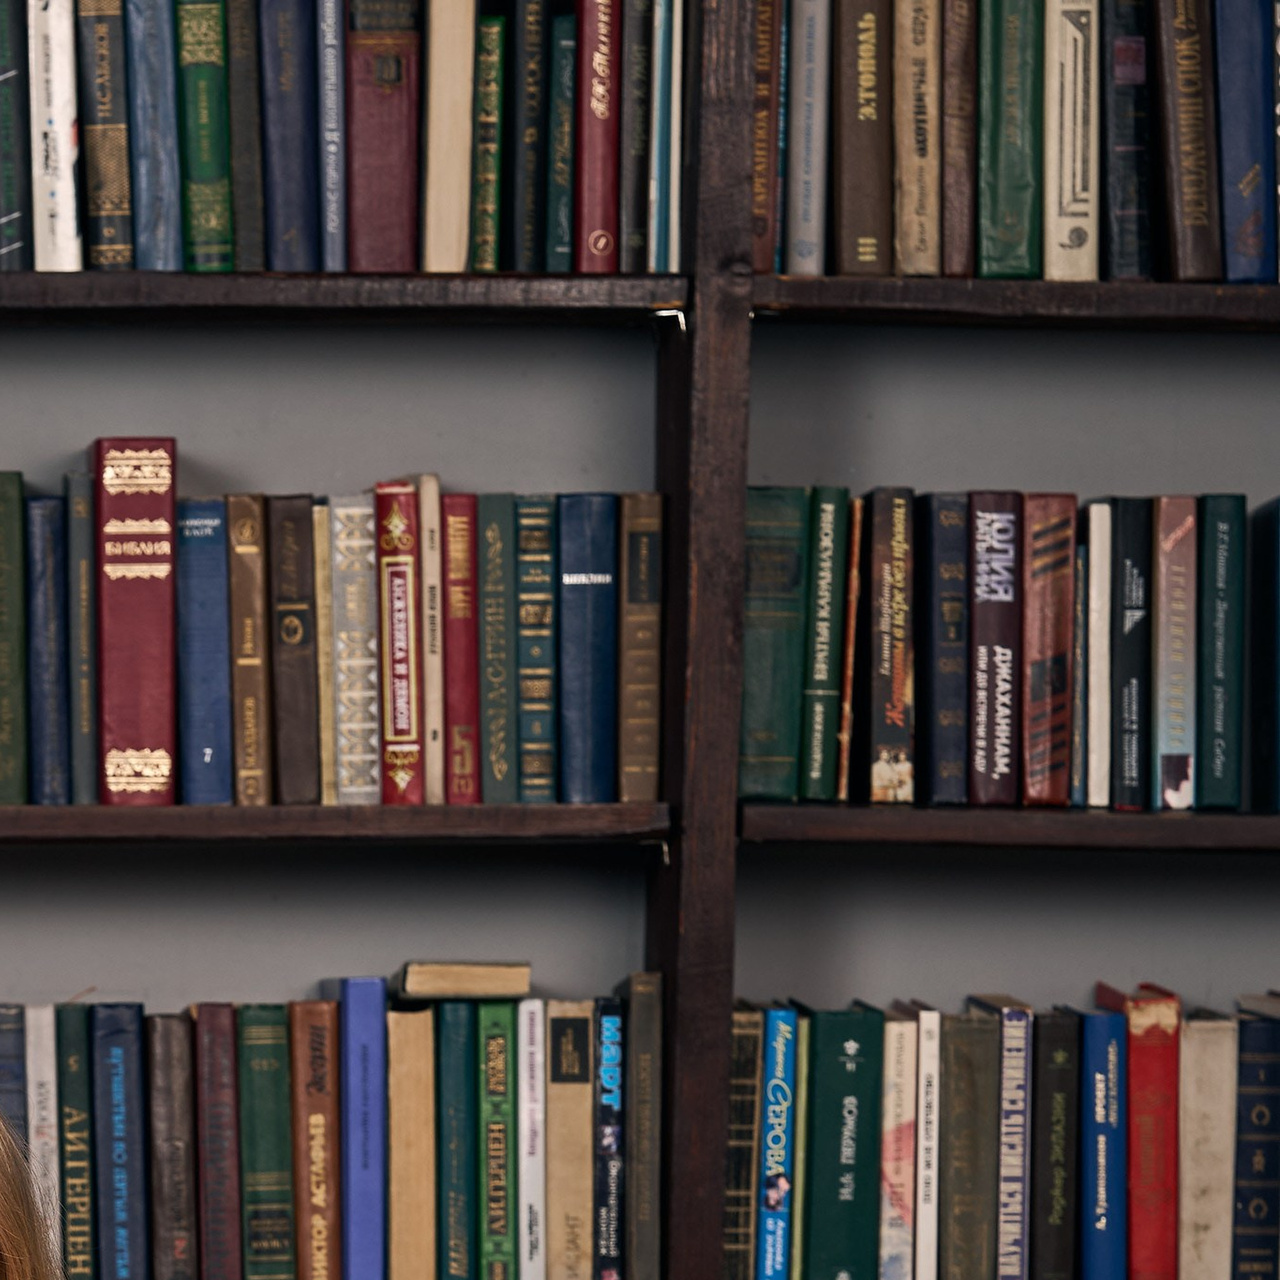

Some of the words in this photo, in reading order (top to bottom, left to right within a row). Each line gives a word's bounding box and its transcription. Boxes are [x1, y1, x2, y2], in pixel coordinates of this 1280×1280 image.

[856, 11, 878, 121] Э.ТОПОЛЬ
[857, 237, 878, 262] III
[815, 502, 836, 618] КАРАМАЗОВЫ
[813, 620, 829, 681] БРАТЬЯ
[1001, 1015, 1027, 1111] СОЧИНЕНИЕ
[306, 1114, 327, 1209] АСТАФЬЕВ
[765, 1076, 792, 1176] СЕРОВА
[840, 1095, 858, 1165] ПЕРУМОВ
[1000, 1114, 1025, 1178] ПИСАТЬ
[999, 1182, 1024, 1277] НАУЧИТЬСЯ
